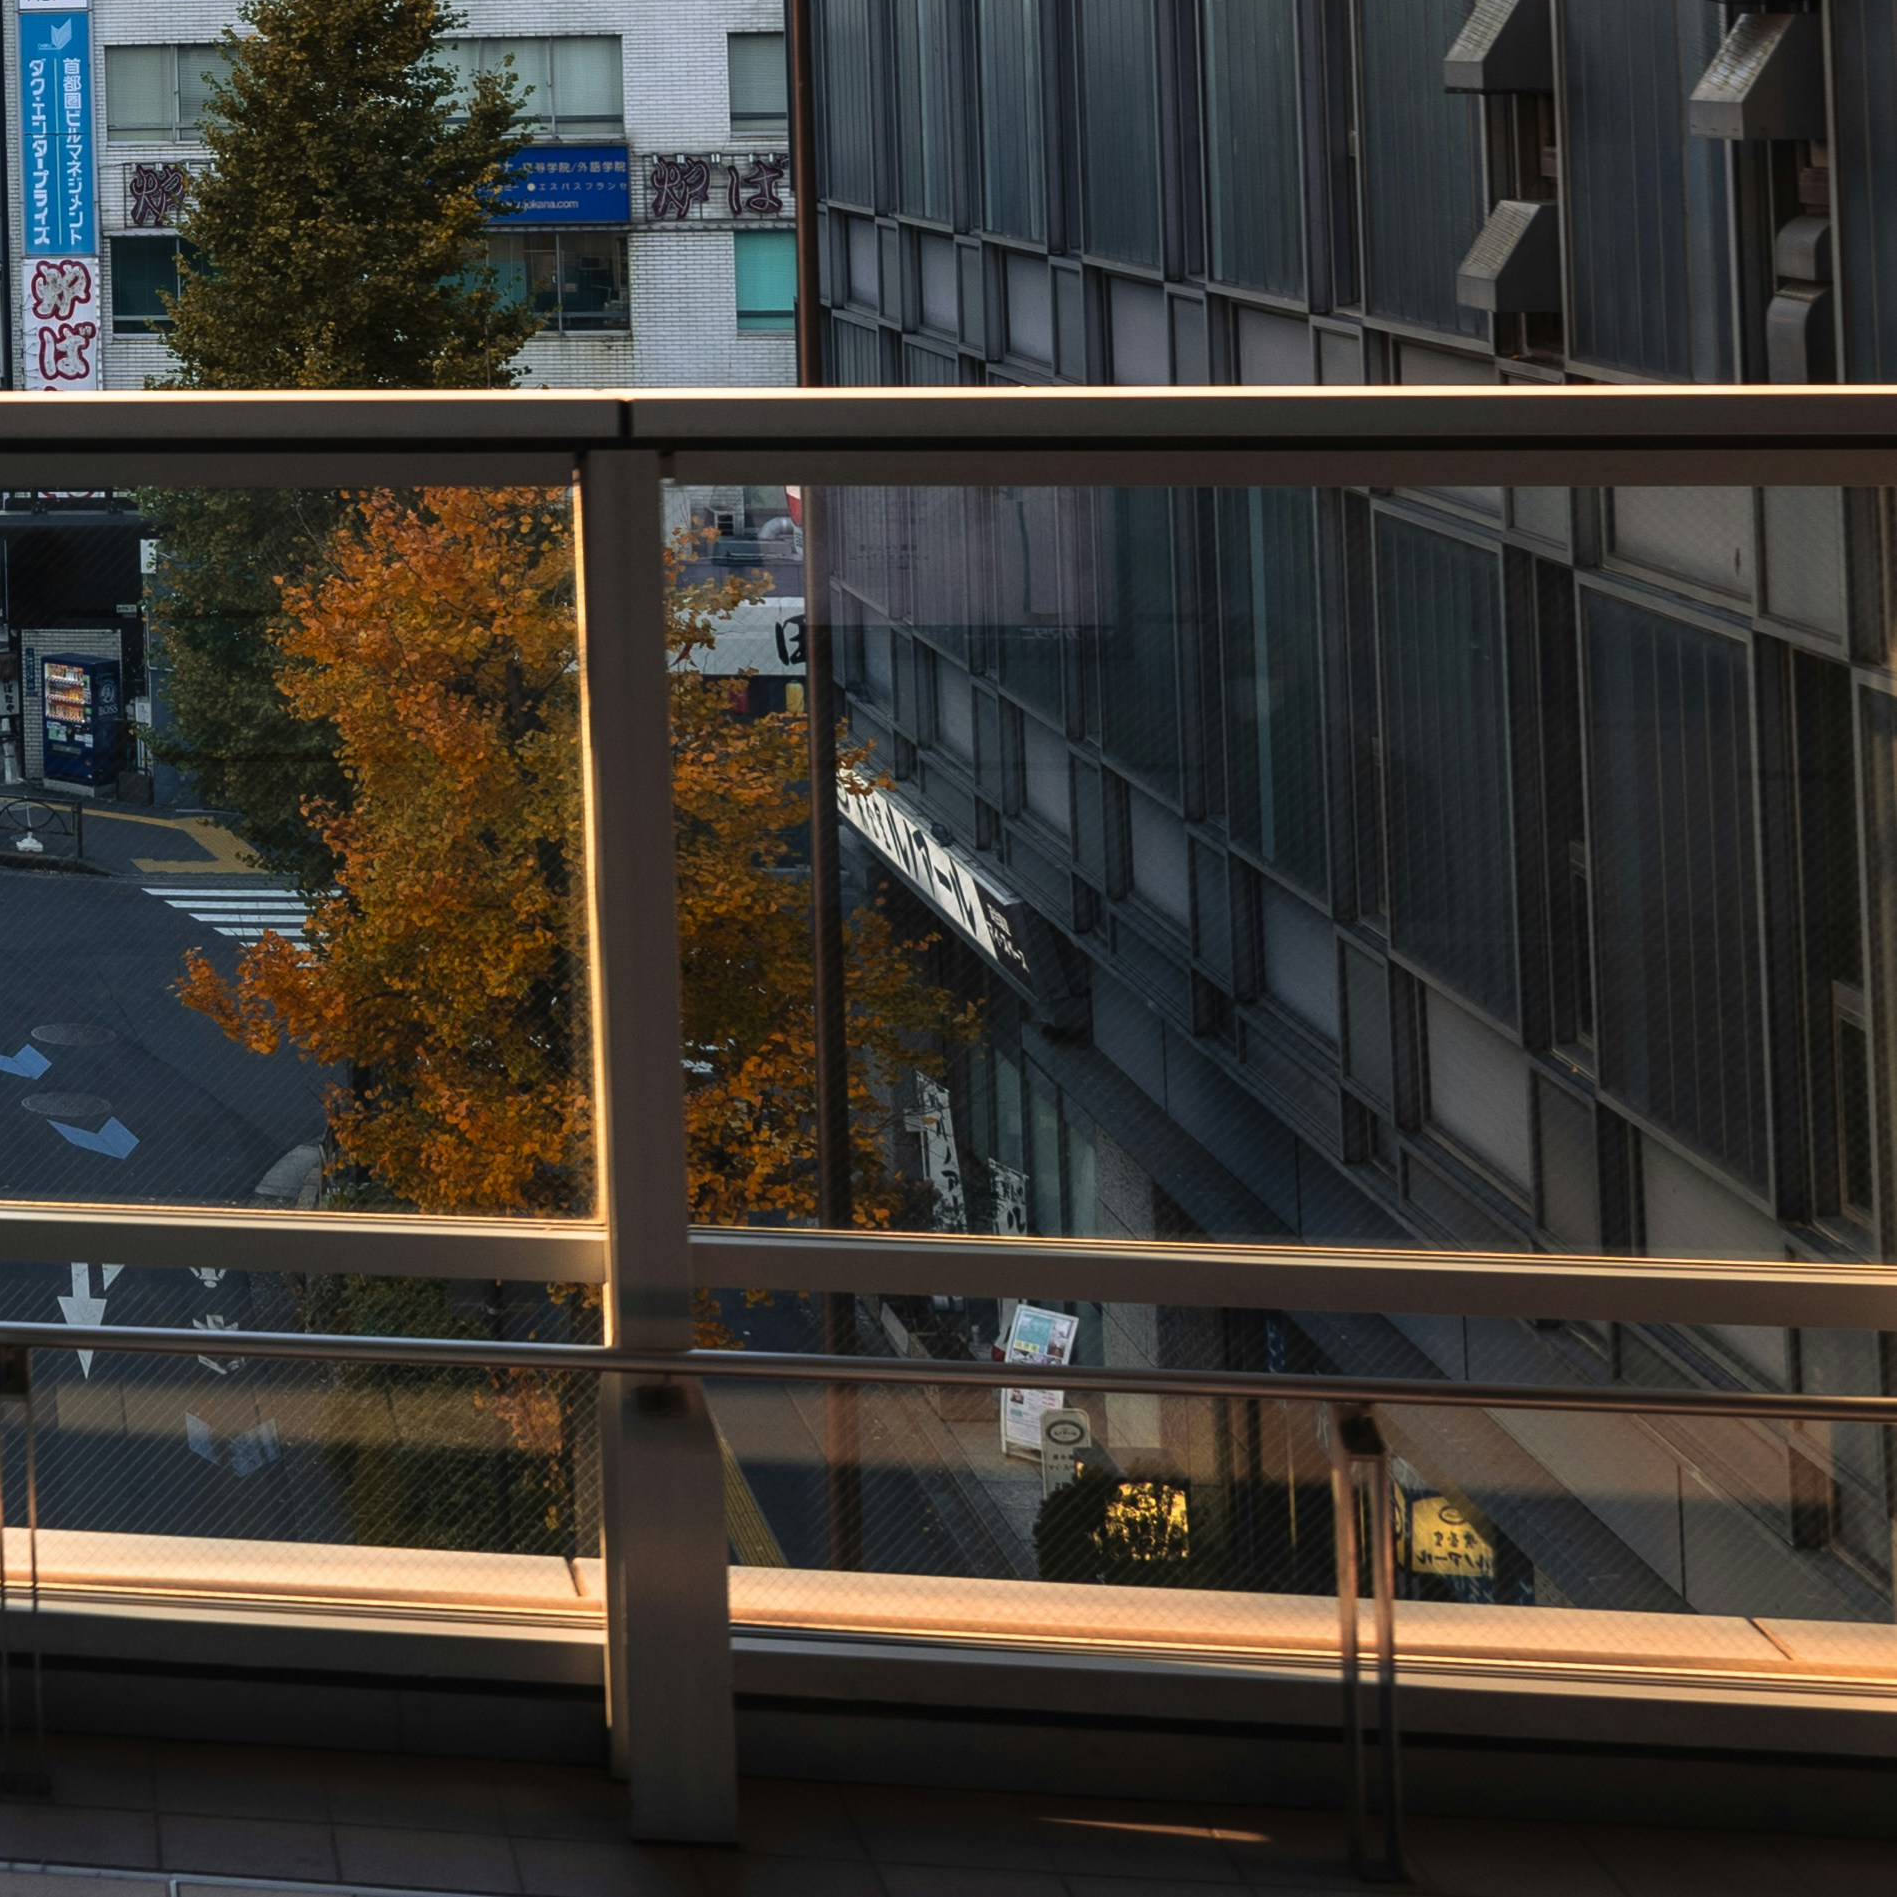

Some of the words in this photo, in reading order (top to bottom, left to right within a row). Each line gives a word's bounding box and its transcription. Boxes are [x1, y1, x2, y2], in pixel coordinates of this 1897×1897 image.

[62, 57, 83, 246] 首都圏ビルマネジメント
[32, 259, 97, 392] 炉ば
[98, 705, 119, 717] BOSS
